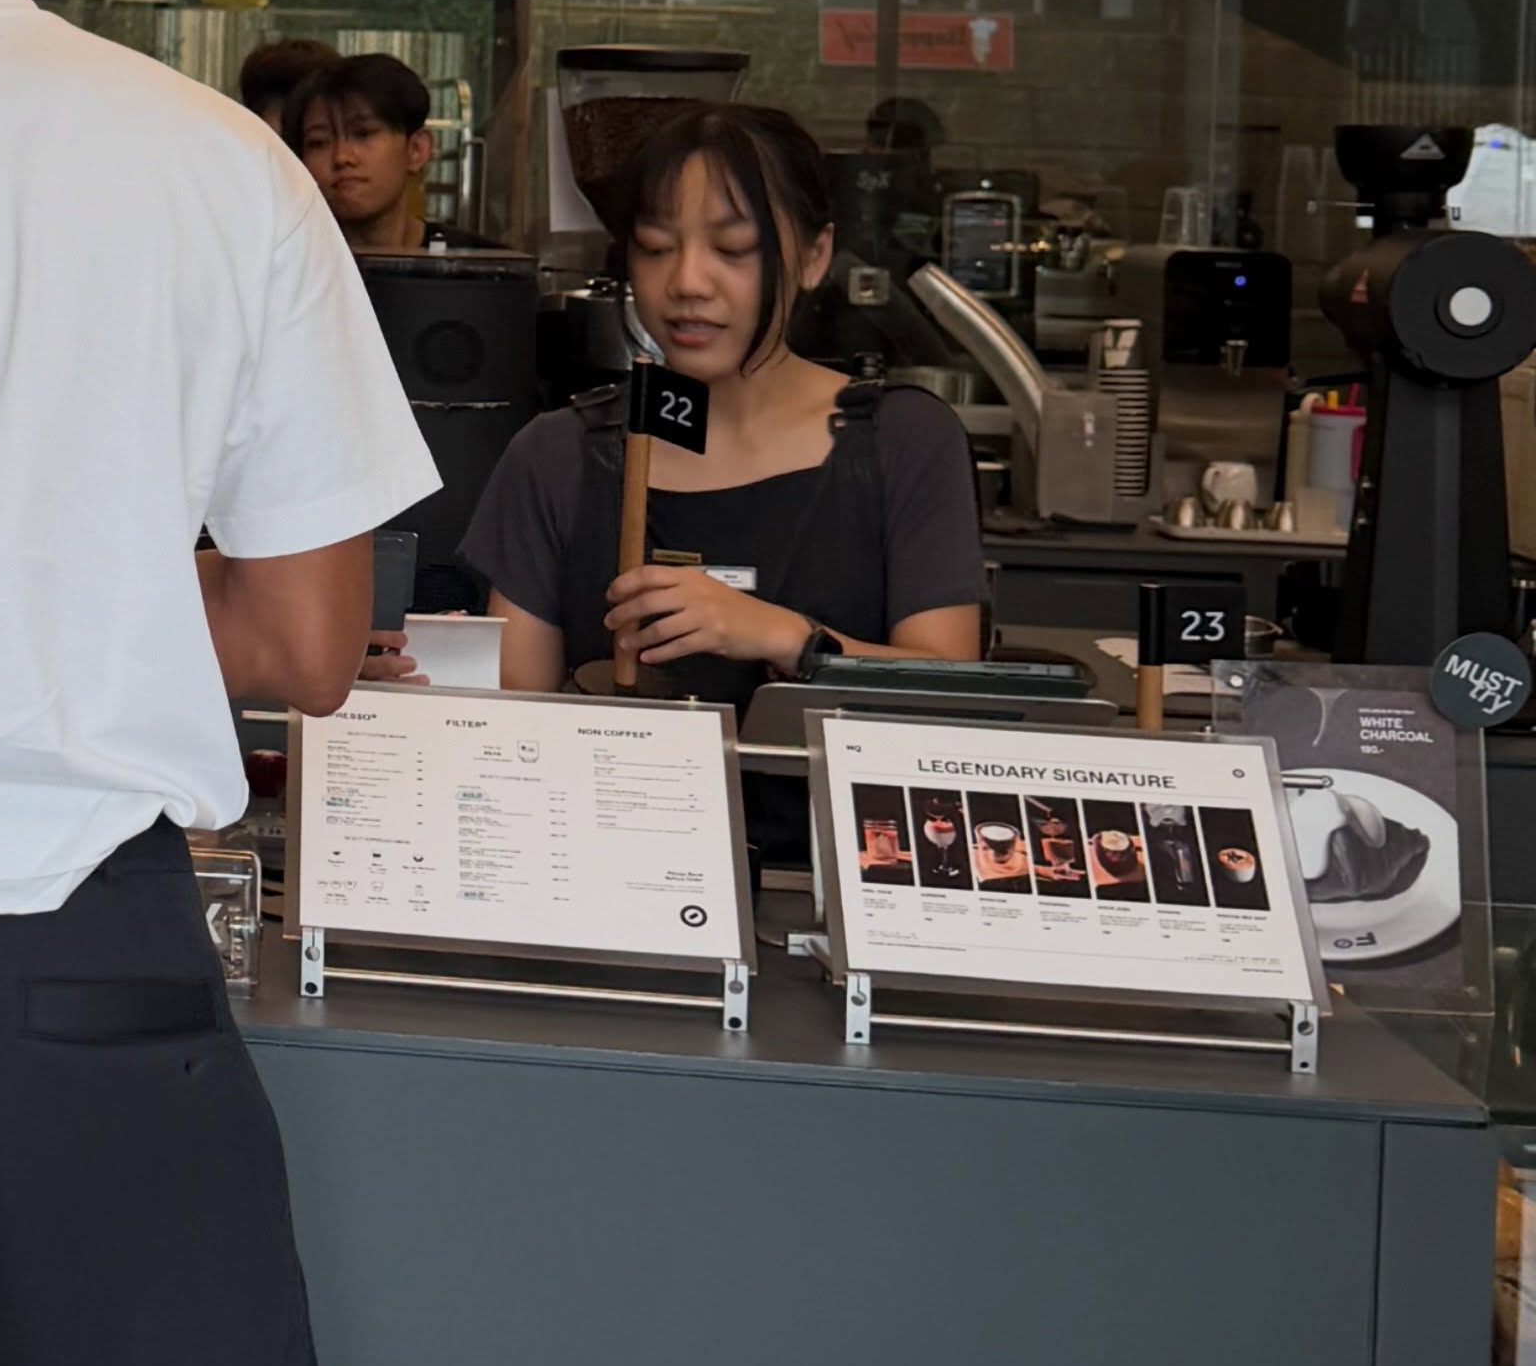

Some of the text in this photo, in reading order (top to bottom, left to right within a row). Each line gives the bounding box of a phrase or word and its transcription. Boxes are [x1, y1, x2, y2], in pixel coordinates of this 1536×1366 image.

[660, 391, 693, 427] 22
[1181, 610, 1225, 641] 23
[1444, 654, 1523, 698] MUST
[1469, 681, 1512, 715] try
[577, 727, 602, 736] NON
[1359, 716, 1404, 729] WHITE
[1359, 729, 1434, 743] CHARCOAL
[917, 758, 1177, 790] LEGENDARY SIGNATURE
